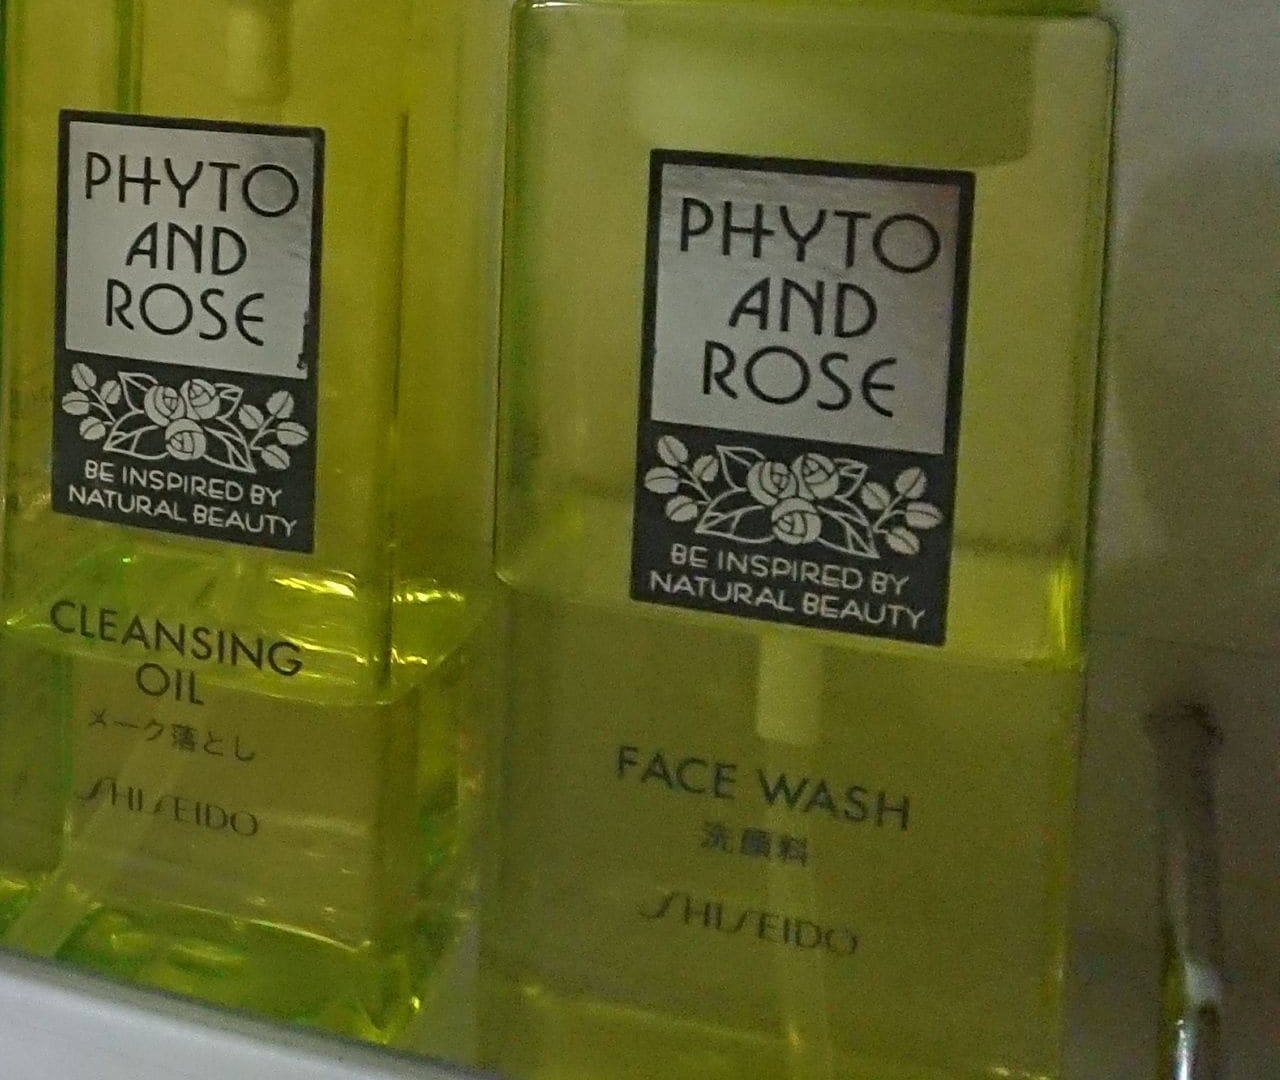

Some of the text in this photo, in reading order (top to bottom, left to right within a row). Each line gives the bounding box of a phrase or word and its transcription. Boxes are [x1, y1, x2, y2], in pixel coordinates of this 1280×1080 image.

[85, 151, 300, 217] PHYTO
[125, 222, 248, 275] AND
[679, 196, 942, 274] PHYTO
[106, 278, 265, 347] ROSE
[728, 276, 878, 338] AND
[702, 339, 898, 418] ROSE
[68, 484, 298, 538] NATURAL BEAUTY
[85, 460, 283, 507] BE INSPIRED BY
[670, 544, 911, 596] BE INSPIRED BY
[650, 572, 926, 630] NATURAL BEAUTY
[50, 599, 303, 676] CLEANSING
[135, 662, 204, 706] OIL
[88, 707, 256, 762] メーク落とし
[77, 776, 259, 837] SHISEIDO
[617, 745, 911, 831] FACE WASH
[639, 891, 860, 955] SHISEIDO
